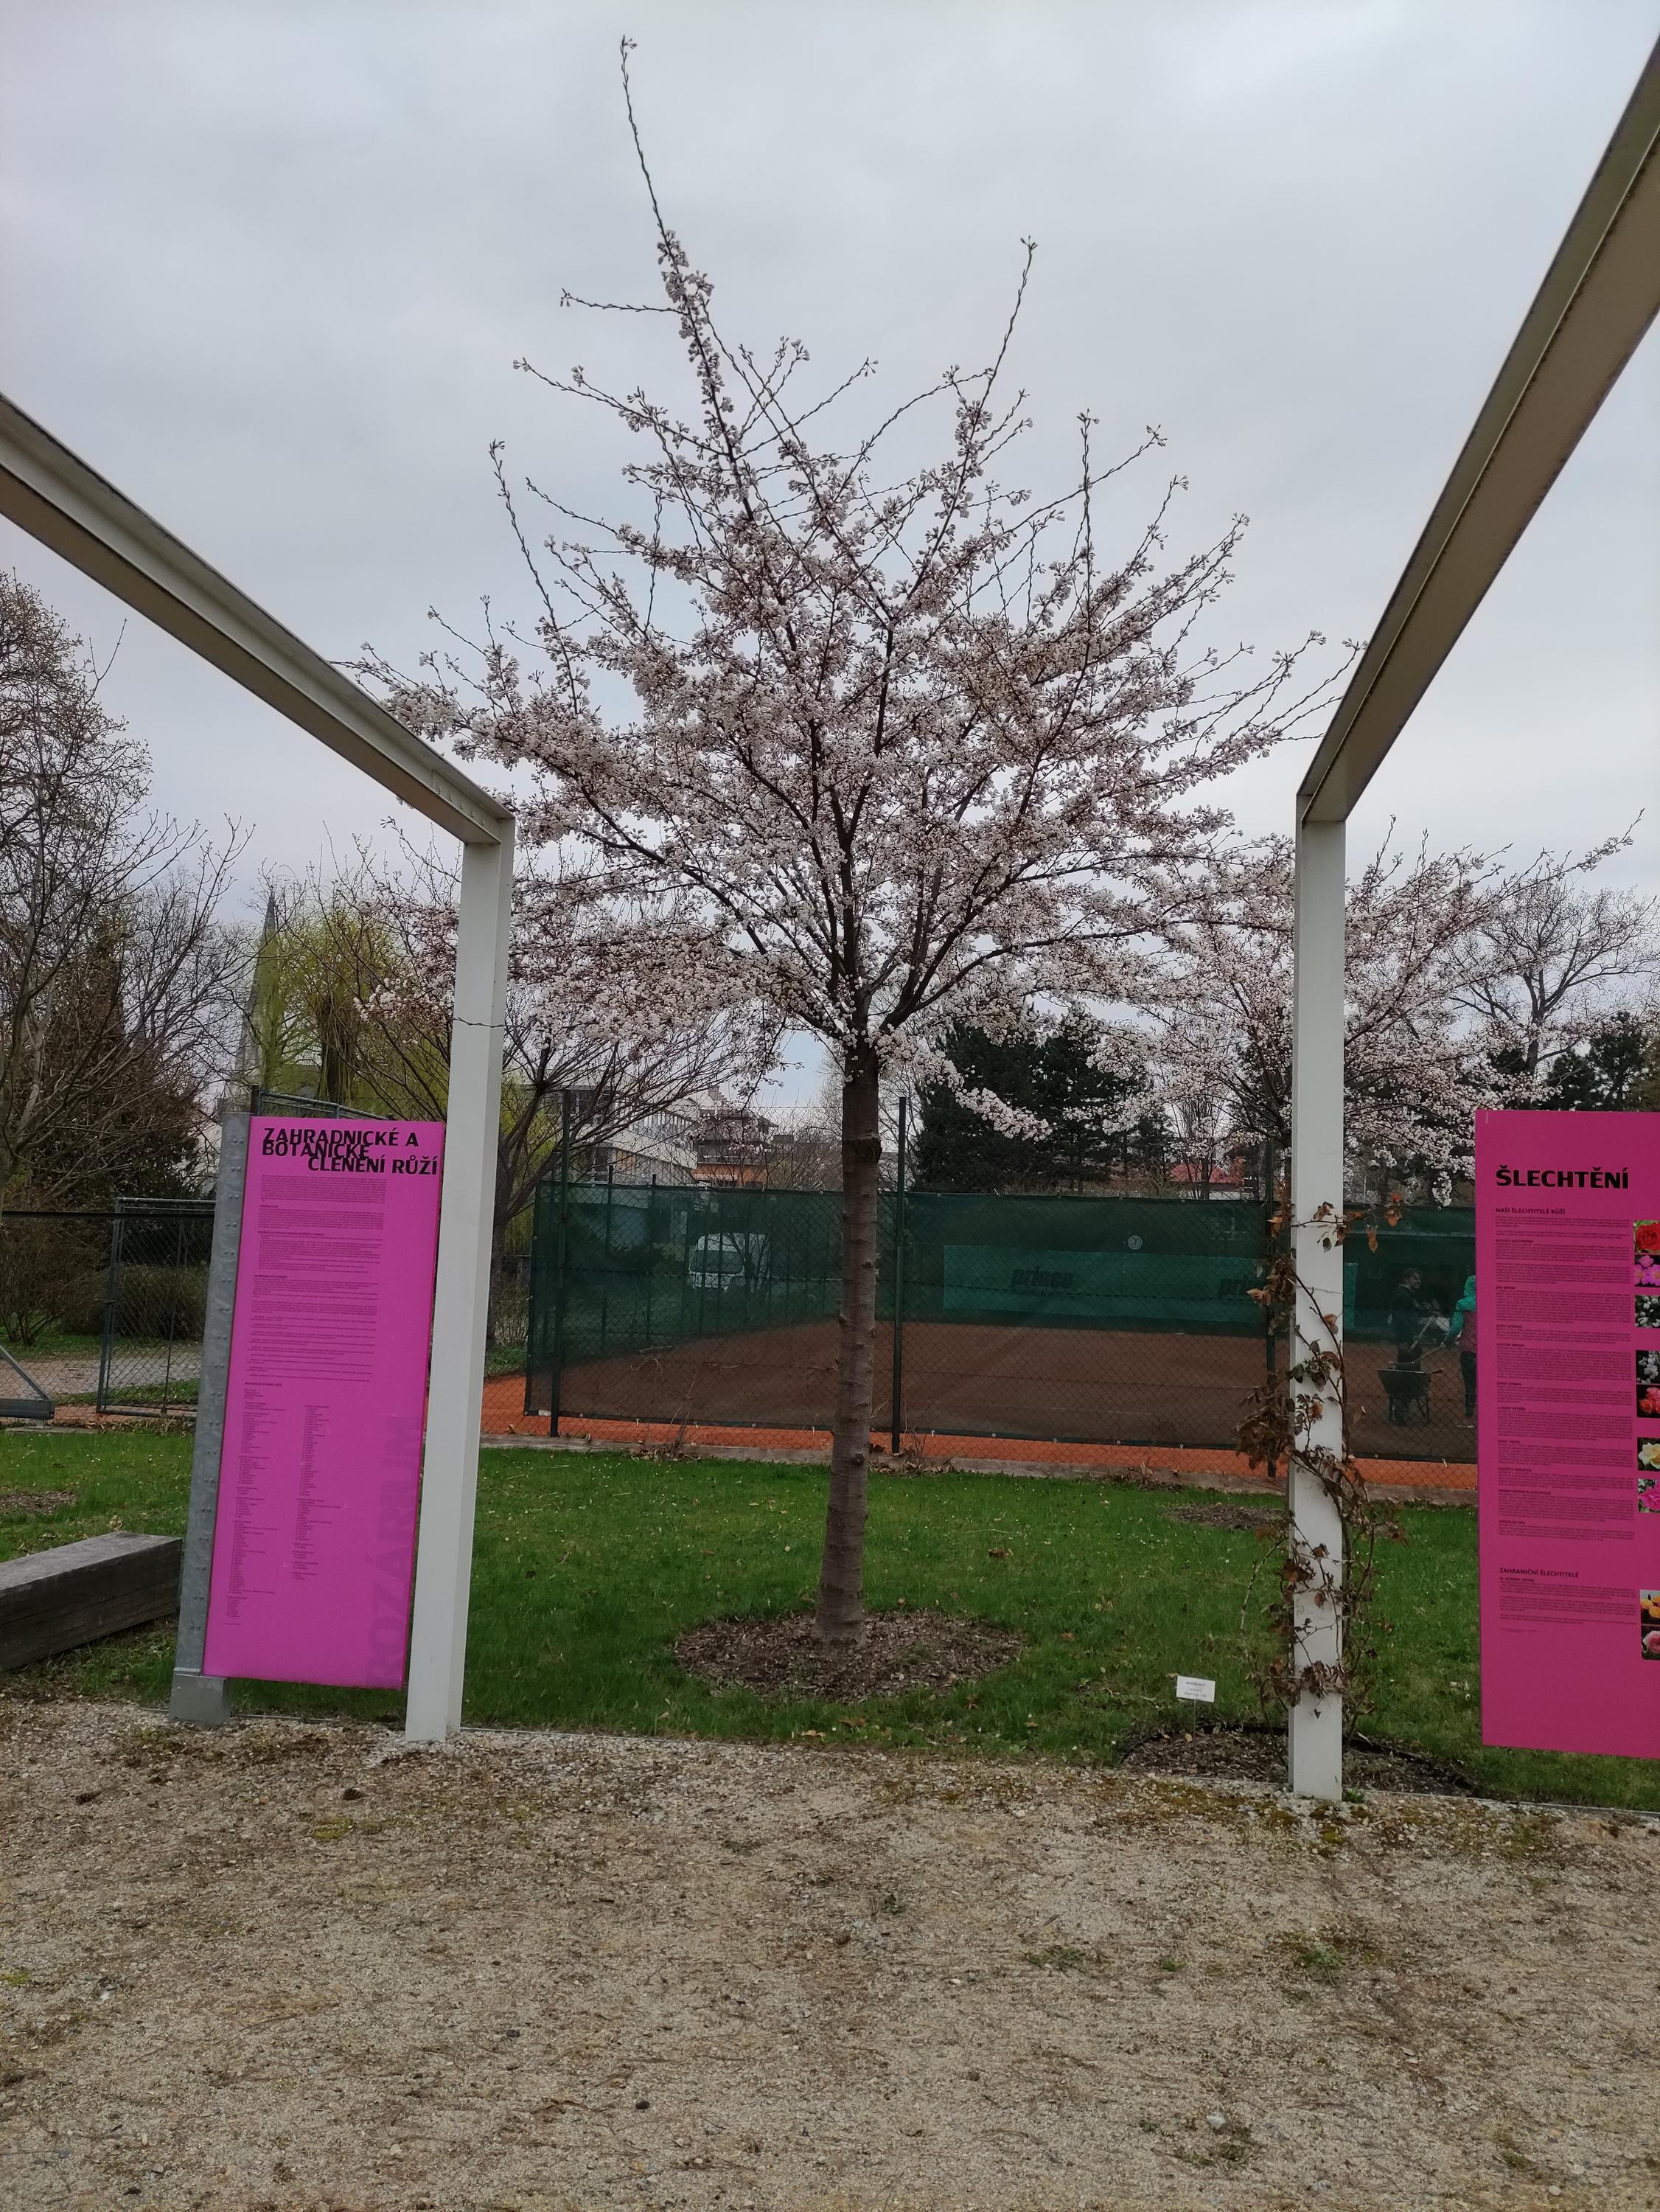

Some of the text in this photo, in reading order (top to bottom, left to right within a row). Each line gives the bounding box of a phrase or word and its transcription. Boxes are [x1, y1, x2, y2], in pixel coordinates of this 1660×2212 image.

[263, 1127, 419, 1147] ZAHRADNICKÉ A
[392, 1155, 438, 1175] RŮŽÍ
[1496, 1164, 1628, 1189] ŠLECHTĚNÍ
[1009, 1265, 1074, 1291] prince
